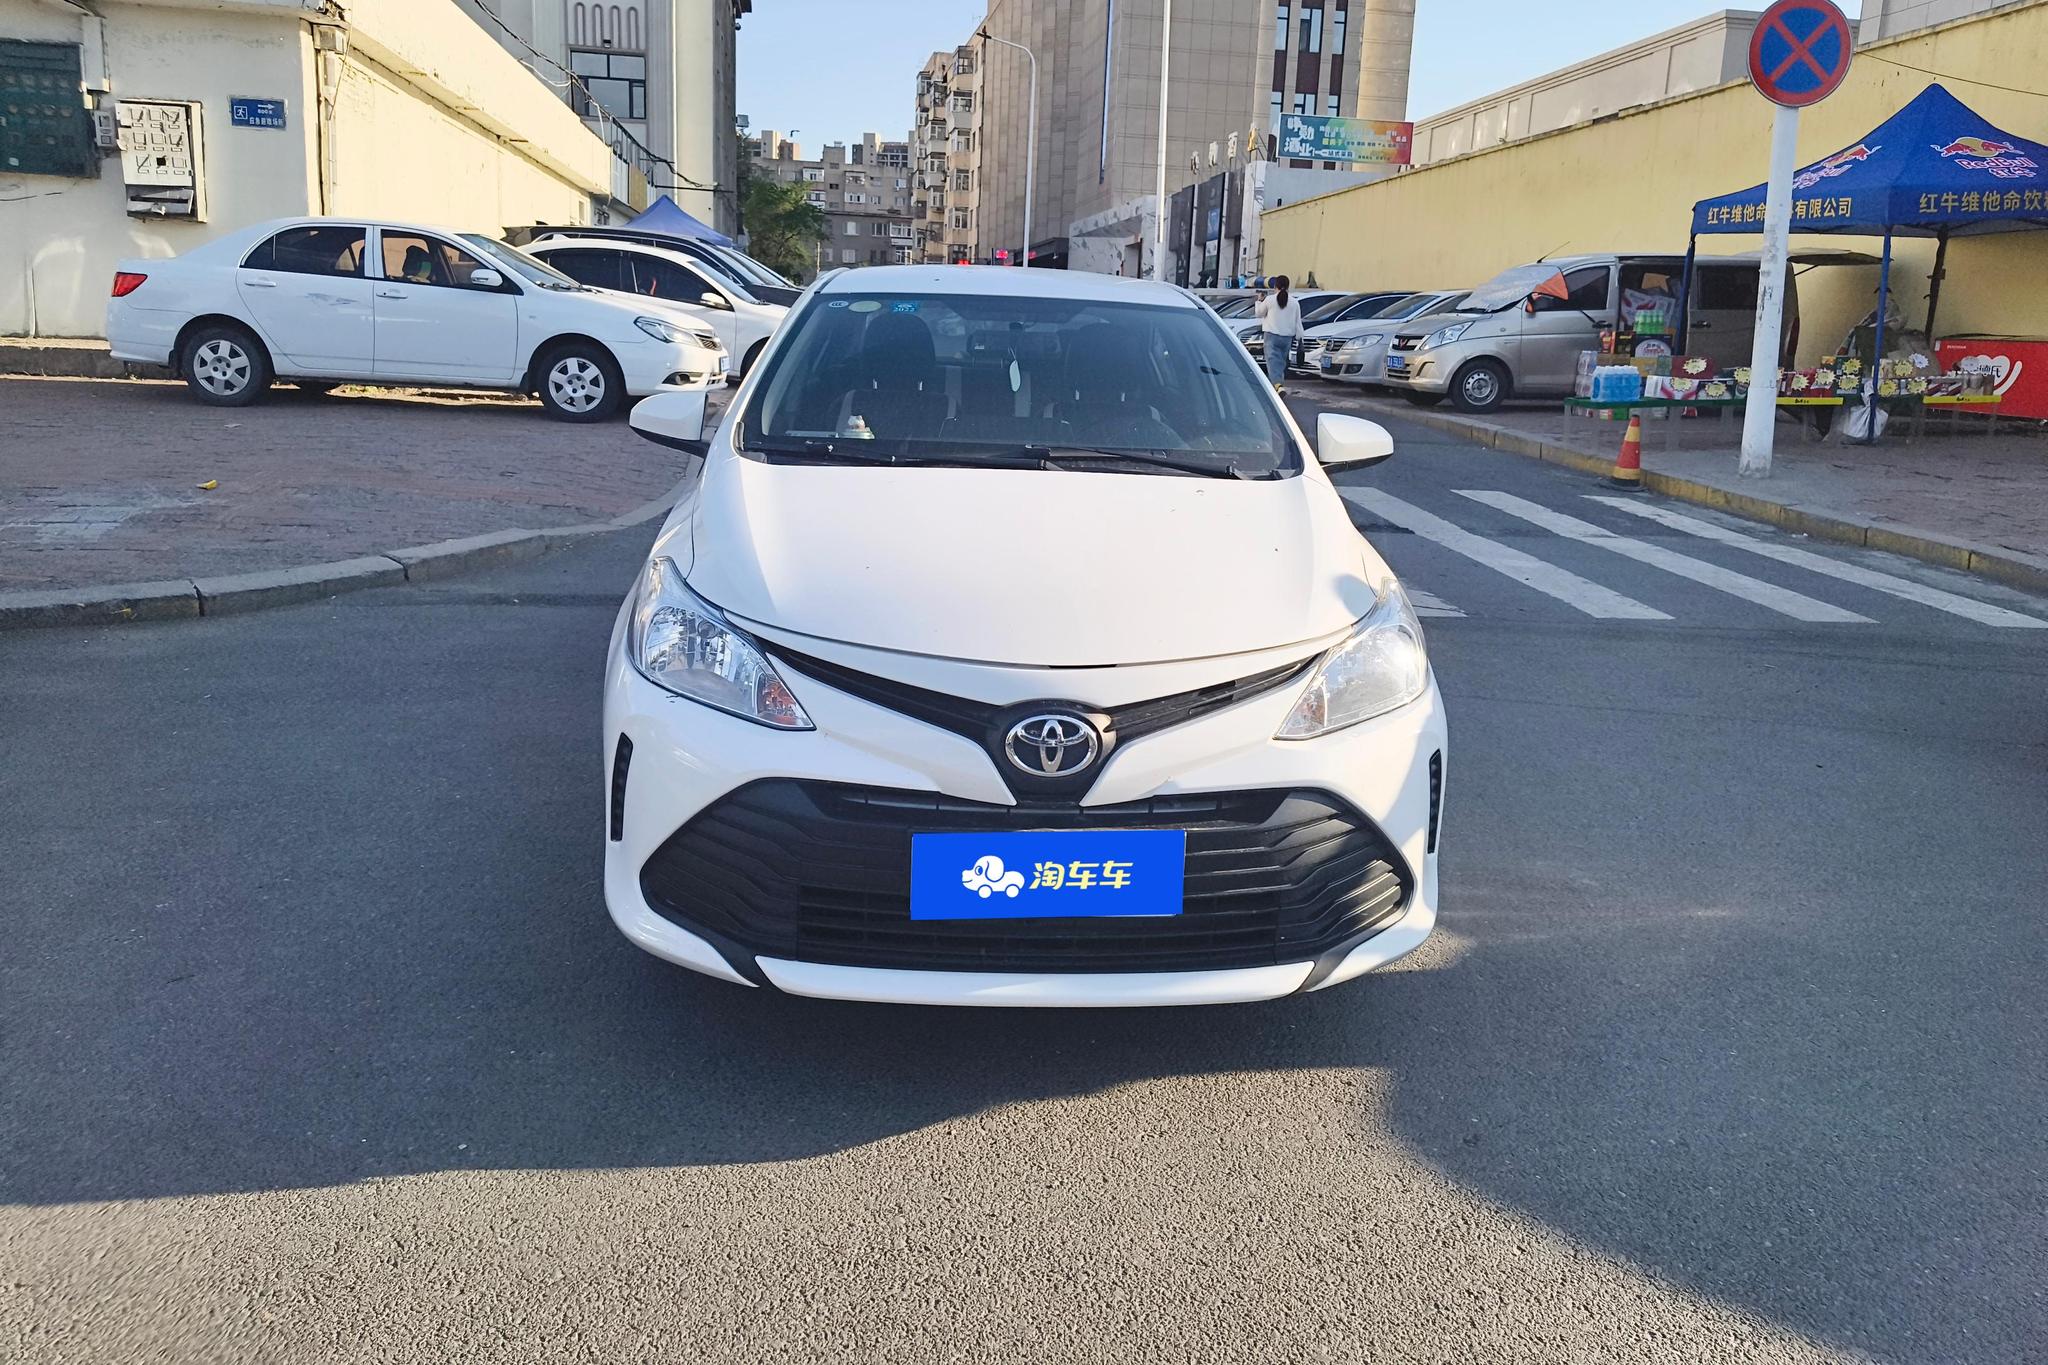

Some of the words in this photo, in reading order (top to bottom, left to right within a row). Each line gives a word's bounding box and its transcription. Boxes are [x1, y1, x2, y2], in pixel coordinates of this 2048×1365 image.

[1707, 197, 1852, 225] 红牛维他命有限公司
[1919, 189, 2048, 214] 红牛维他命饮
